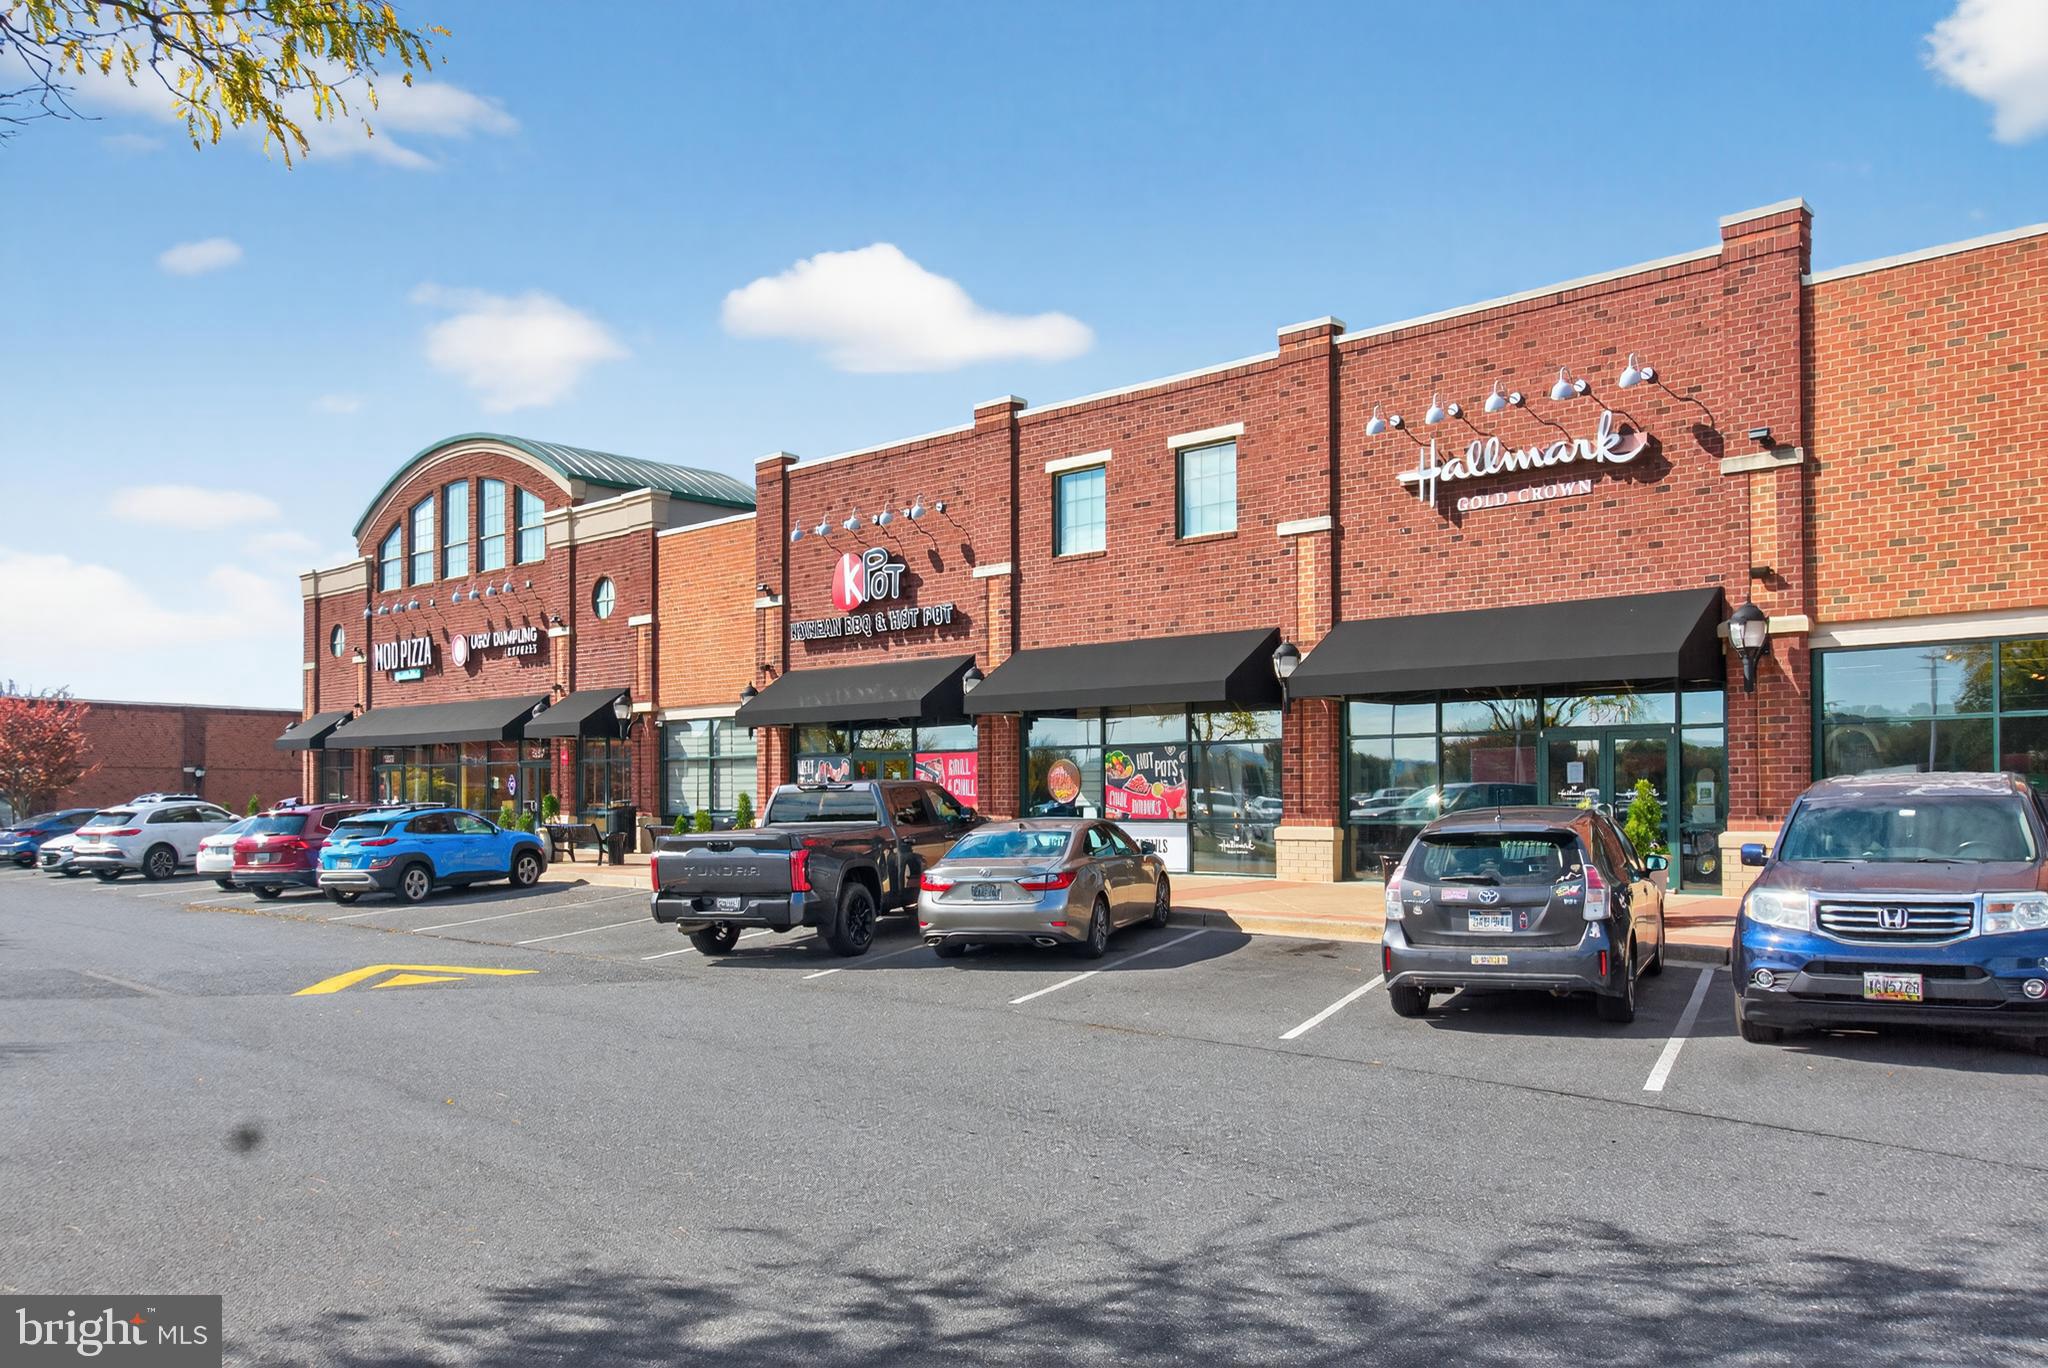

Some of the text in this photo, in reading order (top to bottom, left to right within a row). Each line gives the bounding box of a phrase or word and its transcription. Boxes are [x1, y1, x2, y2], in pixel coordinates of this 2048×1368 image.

[1396, 410, 1647, 508] Hallmark
[1457, 480, 1592, 511] GOLD CROWN
[845, 614, 872, 638] BBQ
[875, 612, 887, 632] &
[888, 608, 920, 631] HOT
[923, 603, 954, 626] POT
[375, 636, 432, 671] MOD PIZZA
[1136, 752, 1154, 770] HOT
[1155, 760, 1179, 777] POTS
[684, 866, 761, 877] TUNDRA
